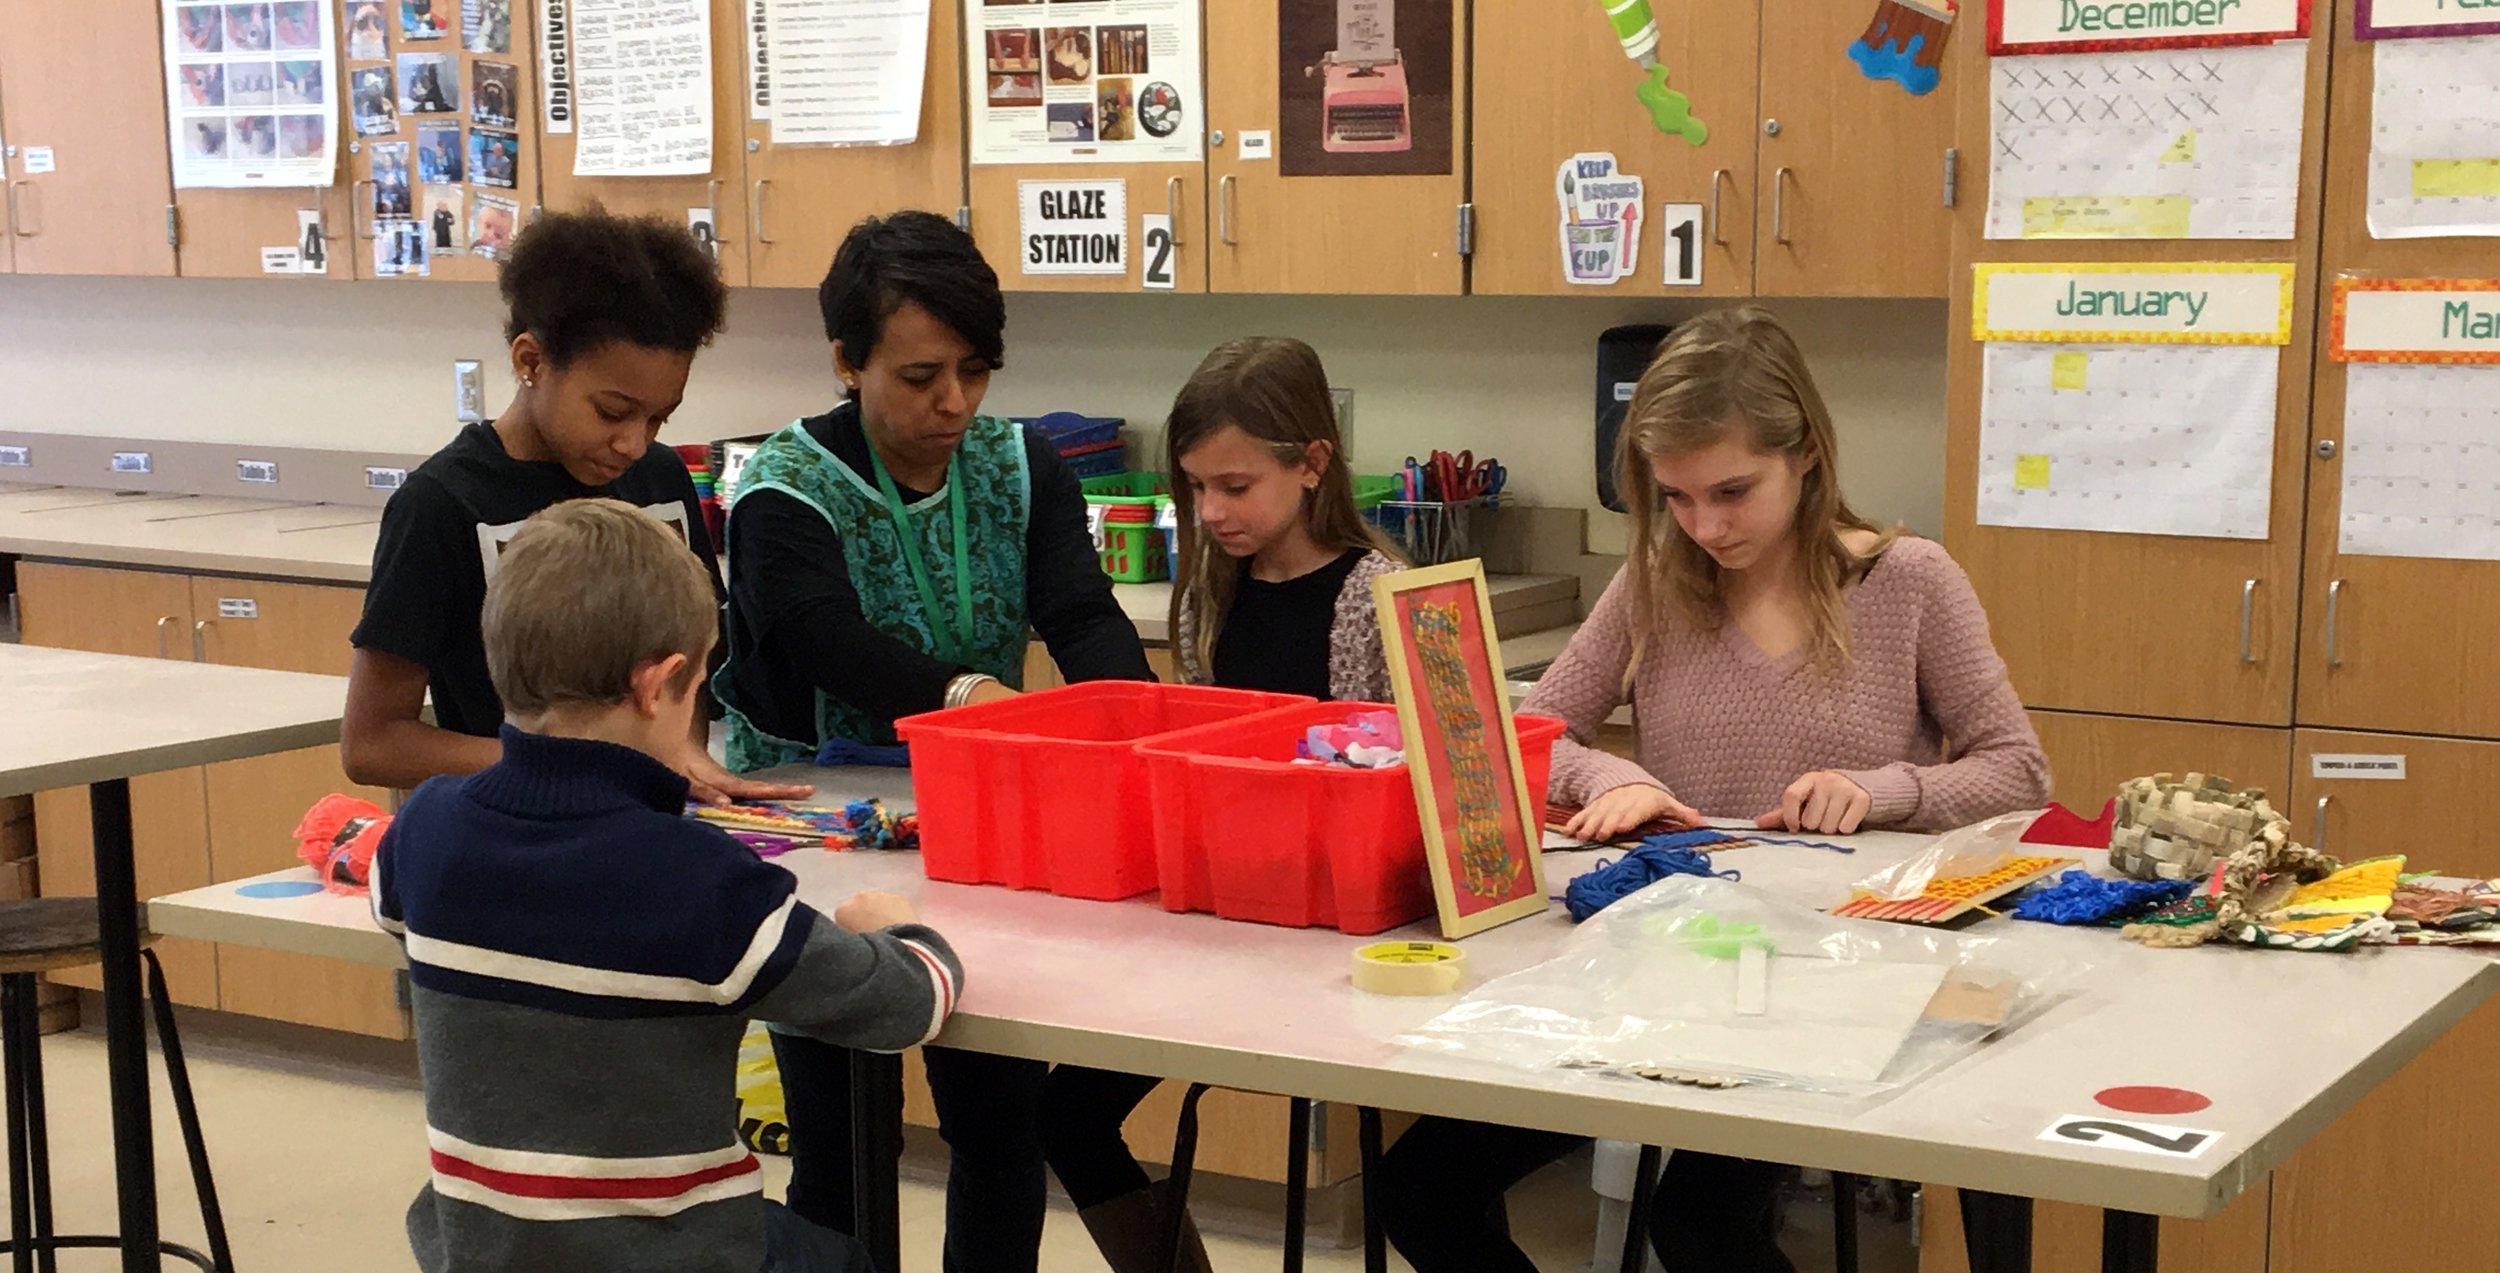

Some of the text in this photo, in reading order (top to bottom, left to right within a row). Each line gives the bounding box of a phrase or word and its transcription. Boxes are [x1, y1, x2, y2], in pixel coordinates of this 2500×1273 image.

[2058, 0, 2241, 32] December
[547, 0, 571, 121] Objective
[1577, 160, 1612, 179] KEEP
[1040, 190, 1107, 220] GLAZE
[1597, 202, 1619, 219] UP
[305, 223, 324, 269] 4
[1029, 234, 1120, 264] STATION
[1147, 228, 1170, 283] 2
[1573, 249, 1610, 271] CUP
[1671, 220, 1694, 279] 1
[2056, 280, 2208, 326] January
[2056, 1121, 2208, 1153] 2
